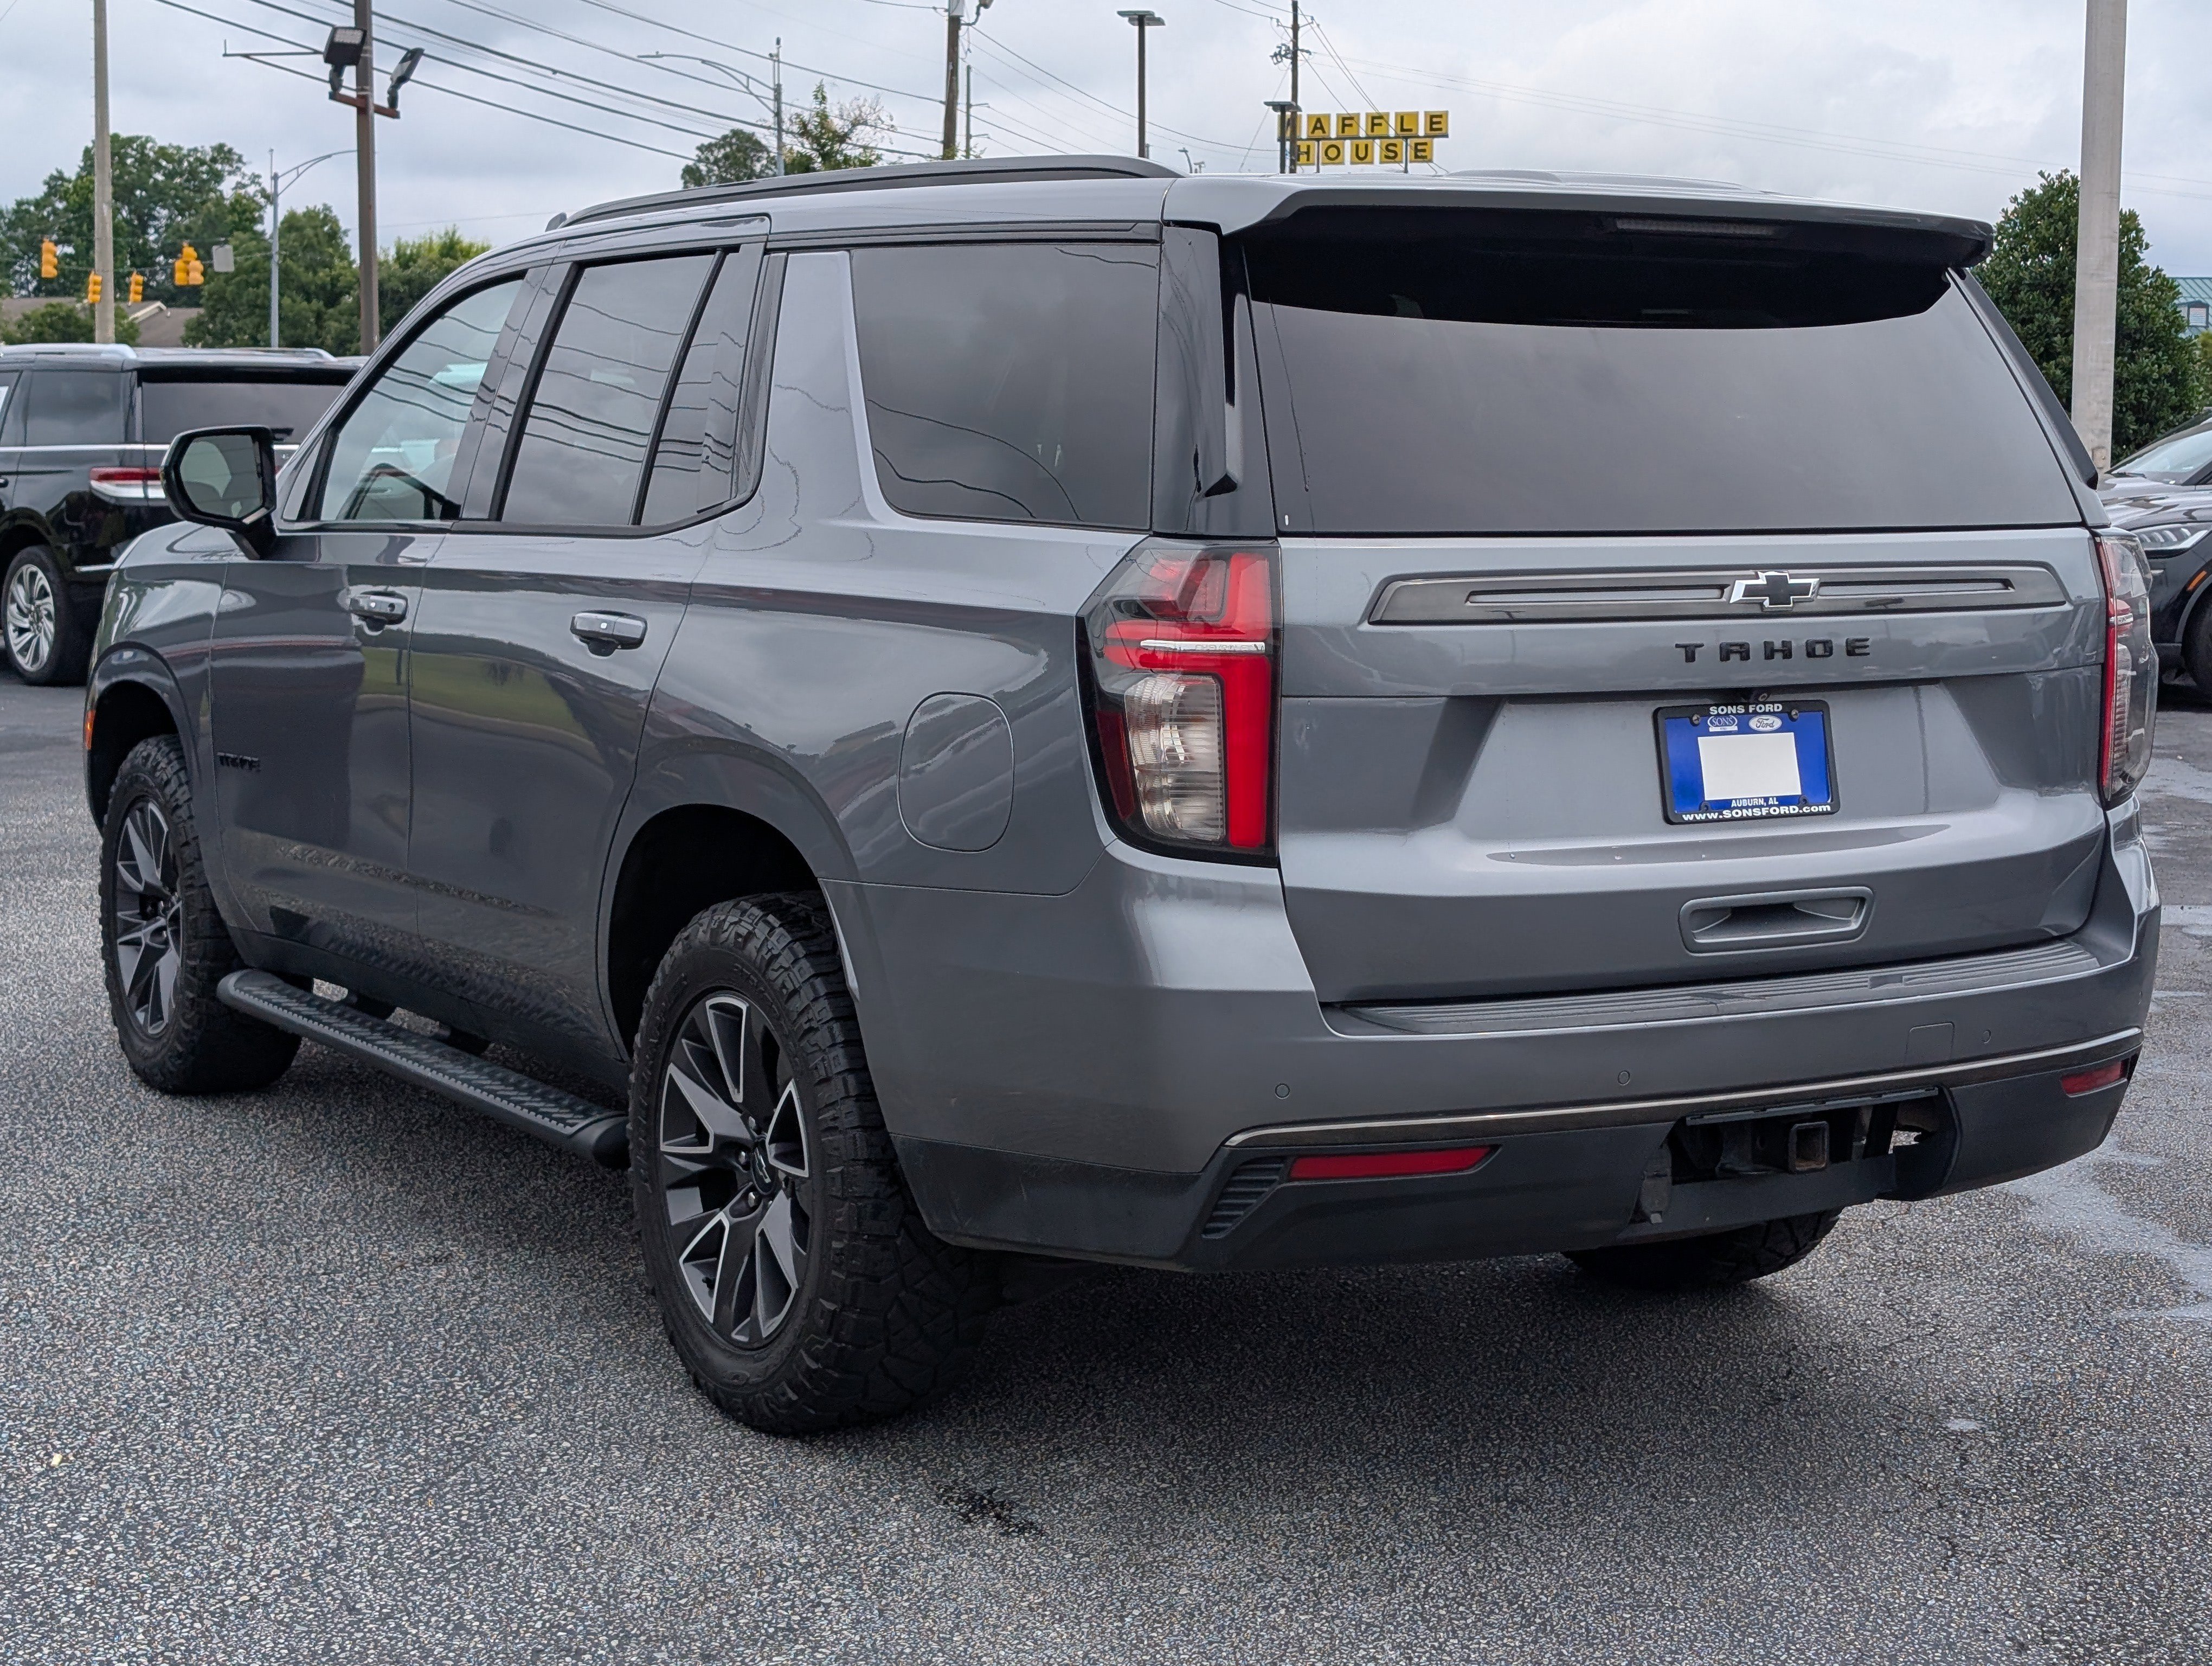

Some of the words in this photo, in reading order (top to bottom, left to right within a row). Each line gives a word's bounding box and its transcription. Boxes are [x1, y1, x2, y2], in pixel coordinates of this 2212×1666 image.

[1296, 142, 1429, 162] HOUSE
[1674, 637, 1870, 663] TAHOE
[1709, 705, 1745, 715] SONS
[1748, 703, 1783, 713] FORD
[1712, 716, 1733, 727] SONS
[1756, 717, 1775, 728] Ford
[1731, 798, 1766, 808] AUBURN,
[1769, 797, 1779, 805] AL
[1682, 805, 1830, 821] www.SONSFORD.com
